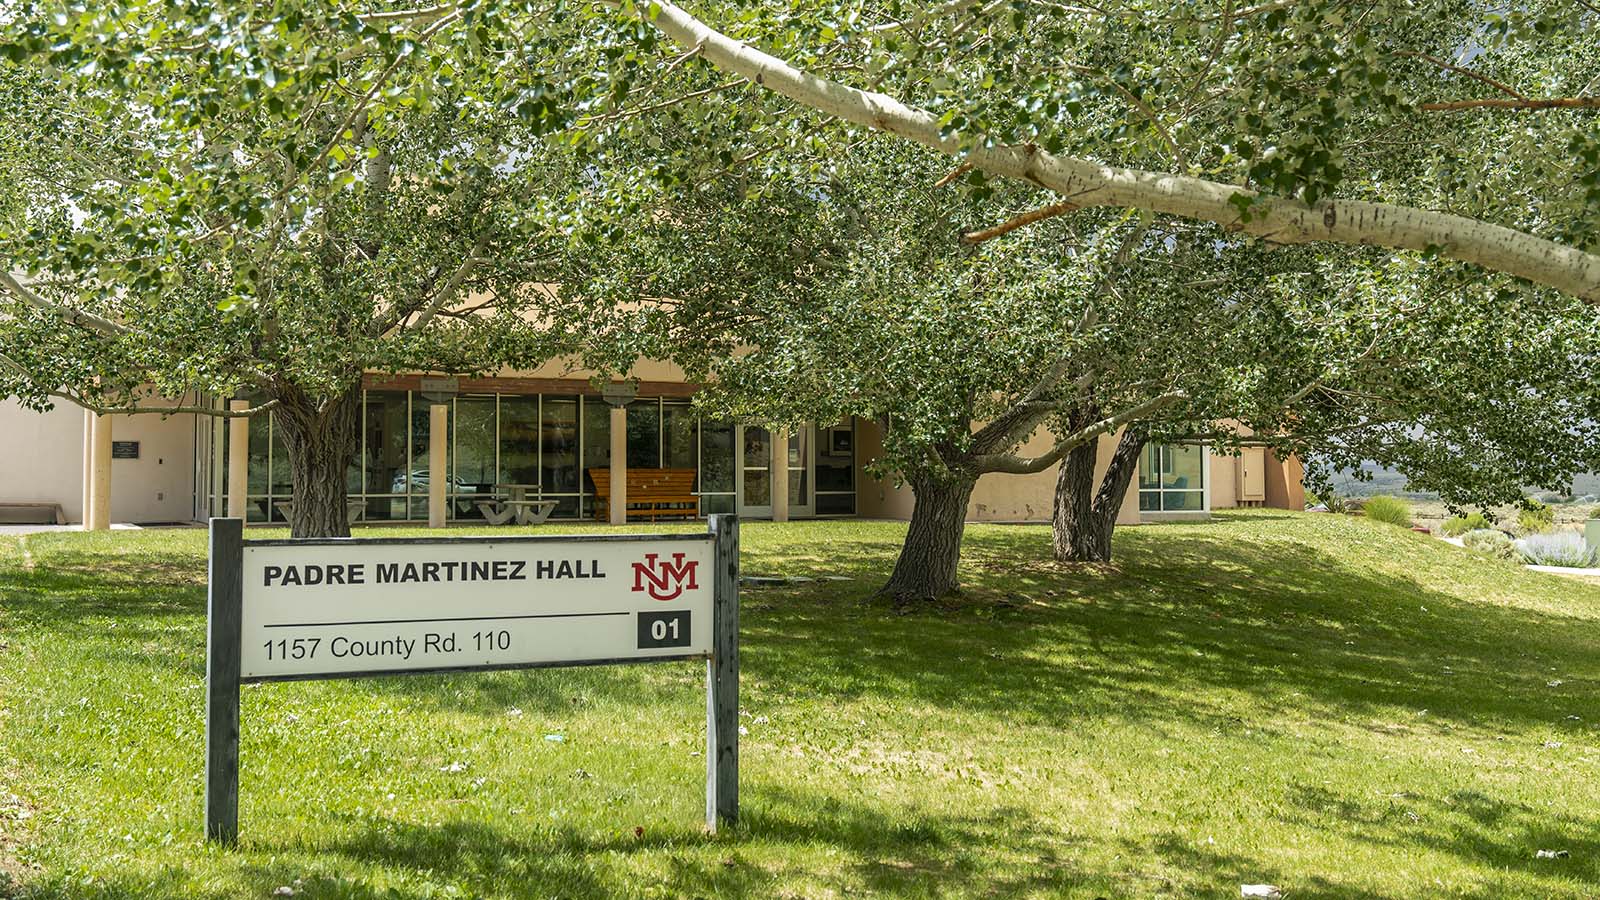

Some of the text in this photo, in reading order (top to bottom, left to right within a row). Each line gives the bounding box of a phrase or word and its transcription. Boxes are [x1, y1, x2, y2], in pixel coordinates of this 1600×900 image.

[264, 559, 607, 587] PADRE MARTINEZ HALL
[651, 618, 679, 640] 01
[263, 630, 511, 662] 1157 County Rd. 110
